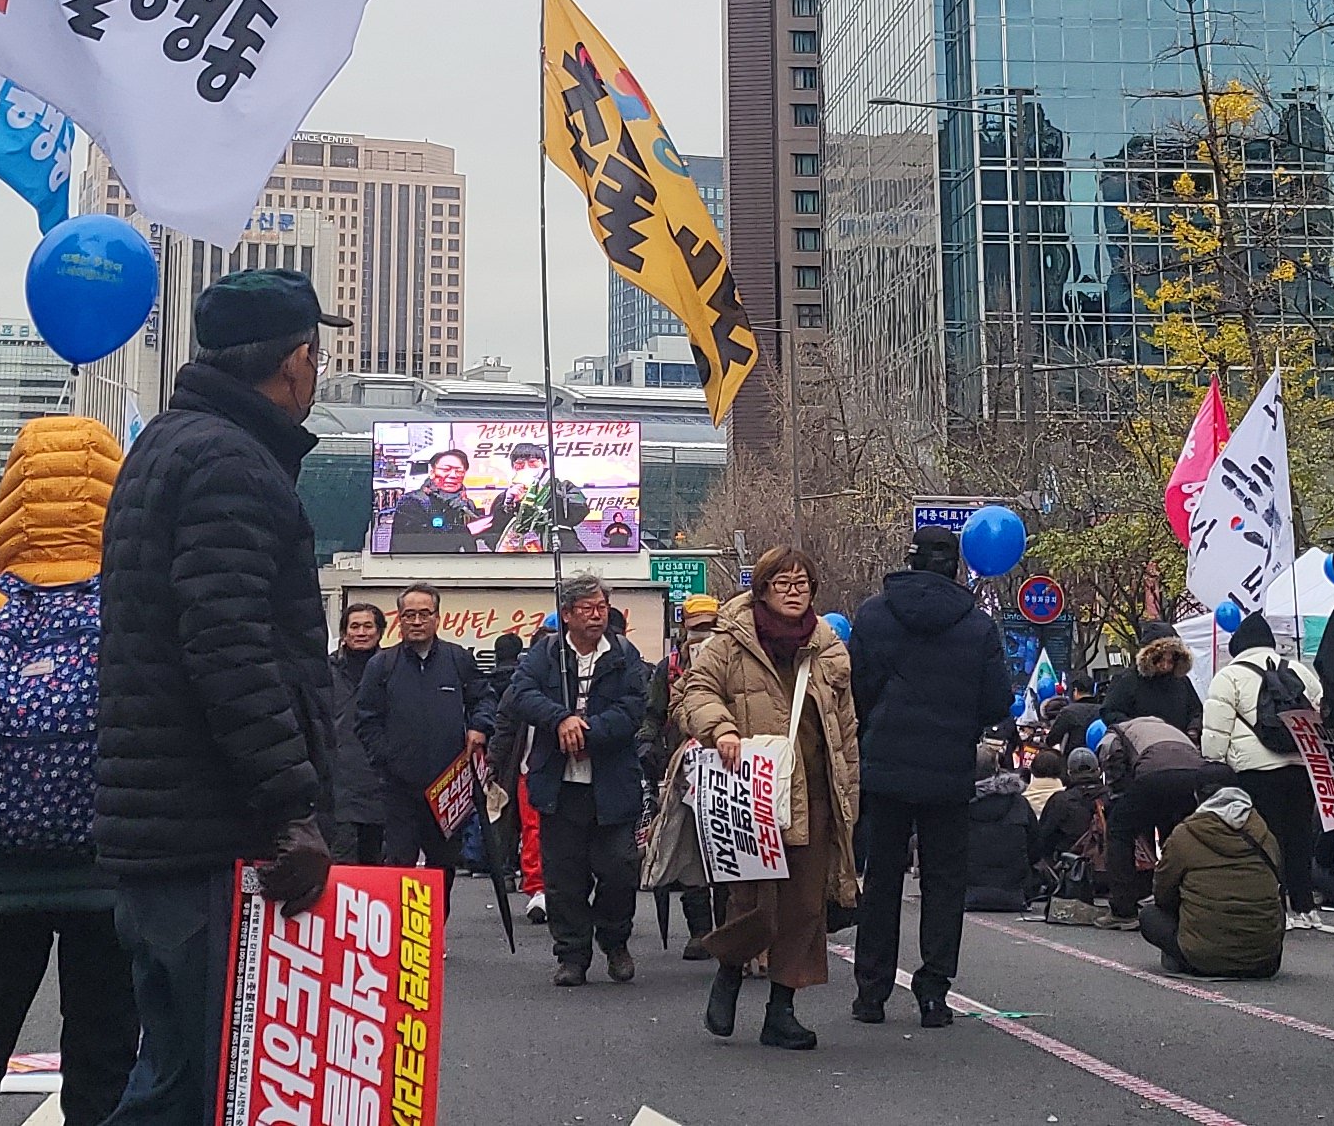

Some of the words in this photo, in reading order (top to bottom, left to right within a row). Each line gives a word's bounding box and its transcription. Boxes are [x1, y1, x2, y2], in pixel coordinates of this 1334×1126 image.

[291, 134, 319, 142] ANCE
[320, 134, 354, 144] CENTER
[708, 768, 742, 878] 탄핵하자!
[751, 754, 782, 871] 친일매국노
[398, 875, 432, 1012] 건희방탄
